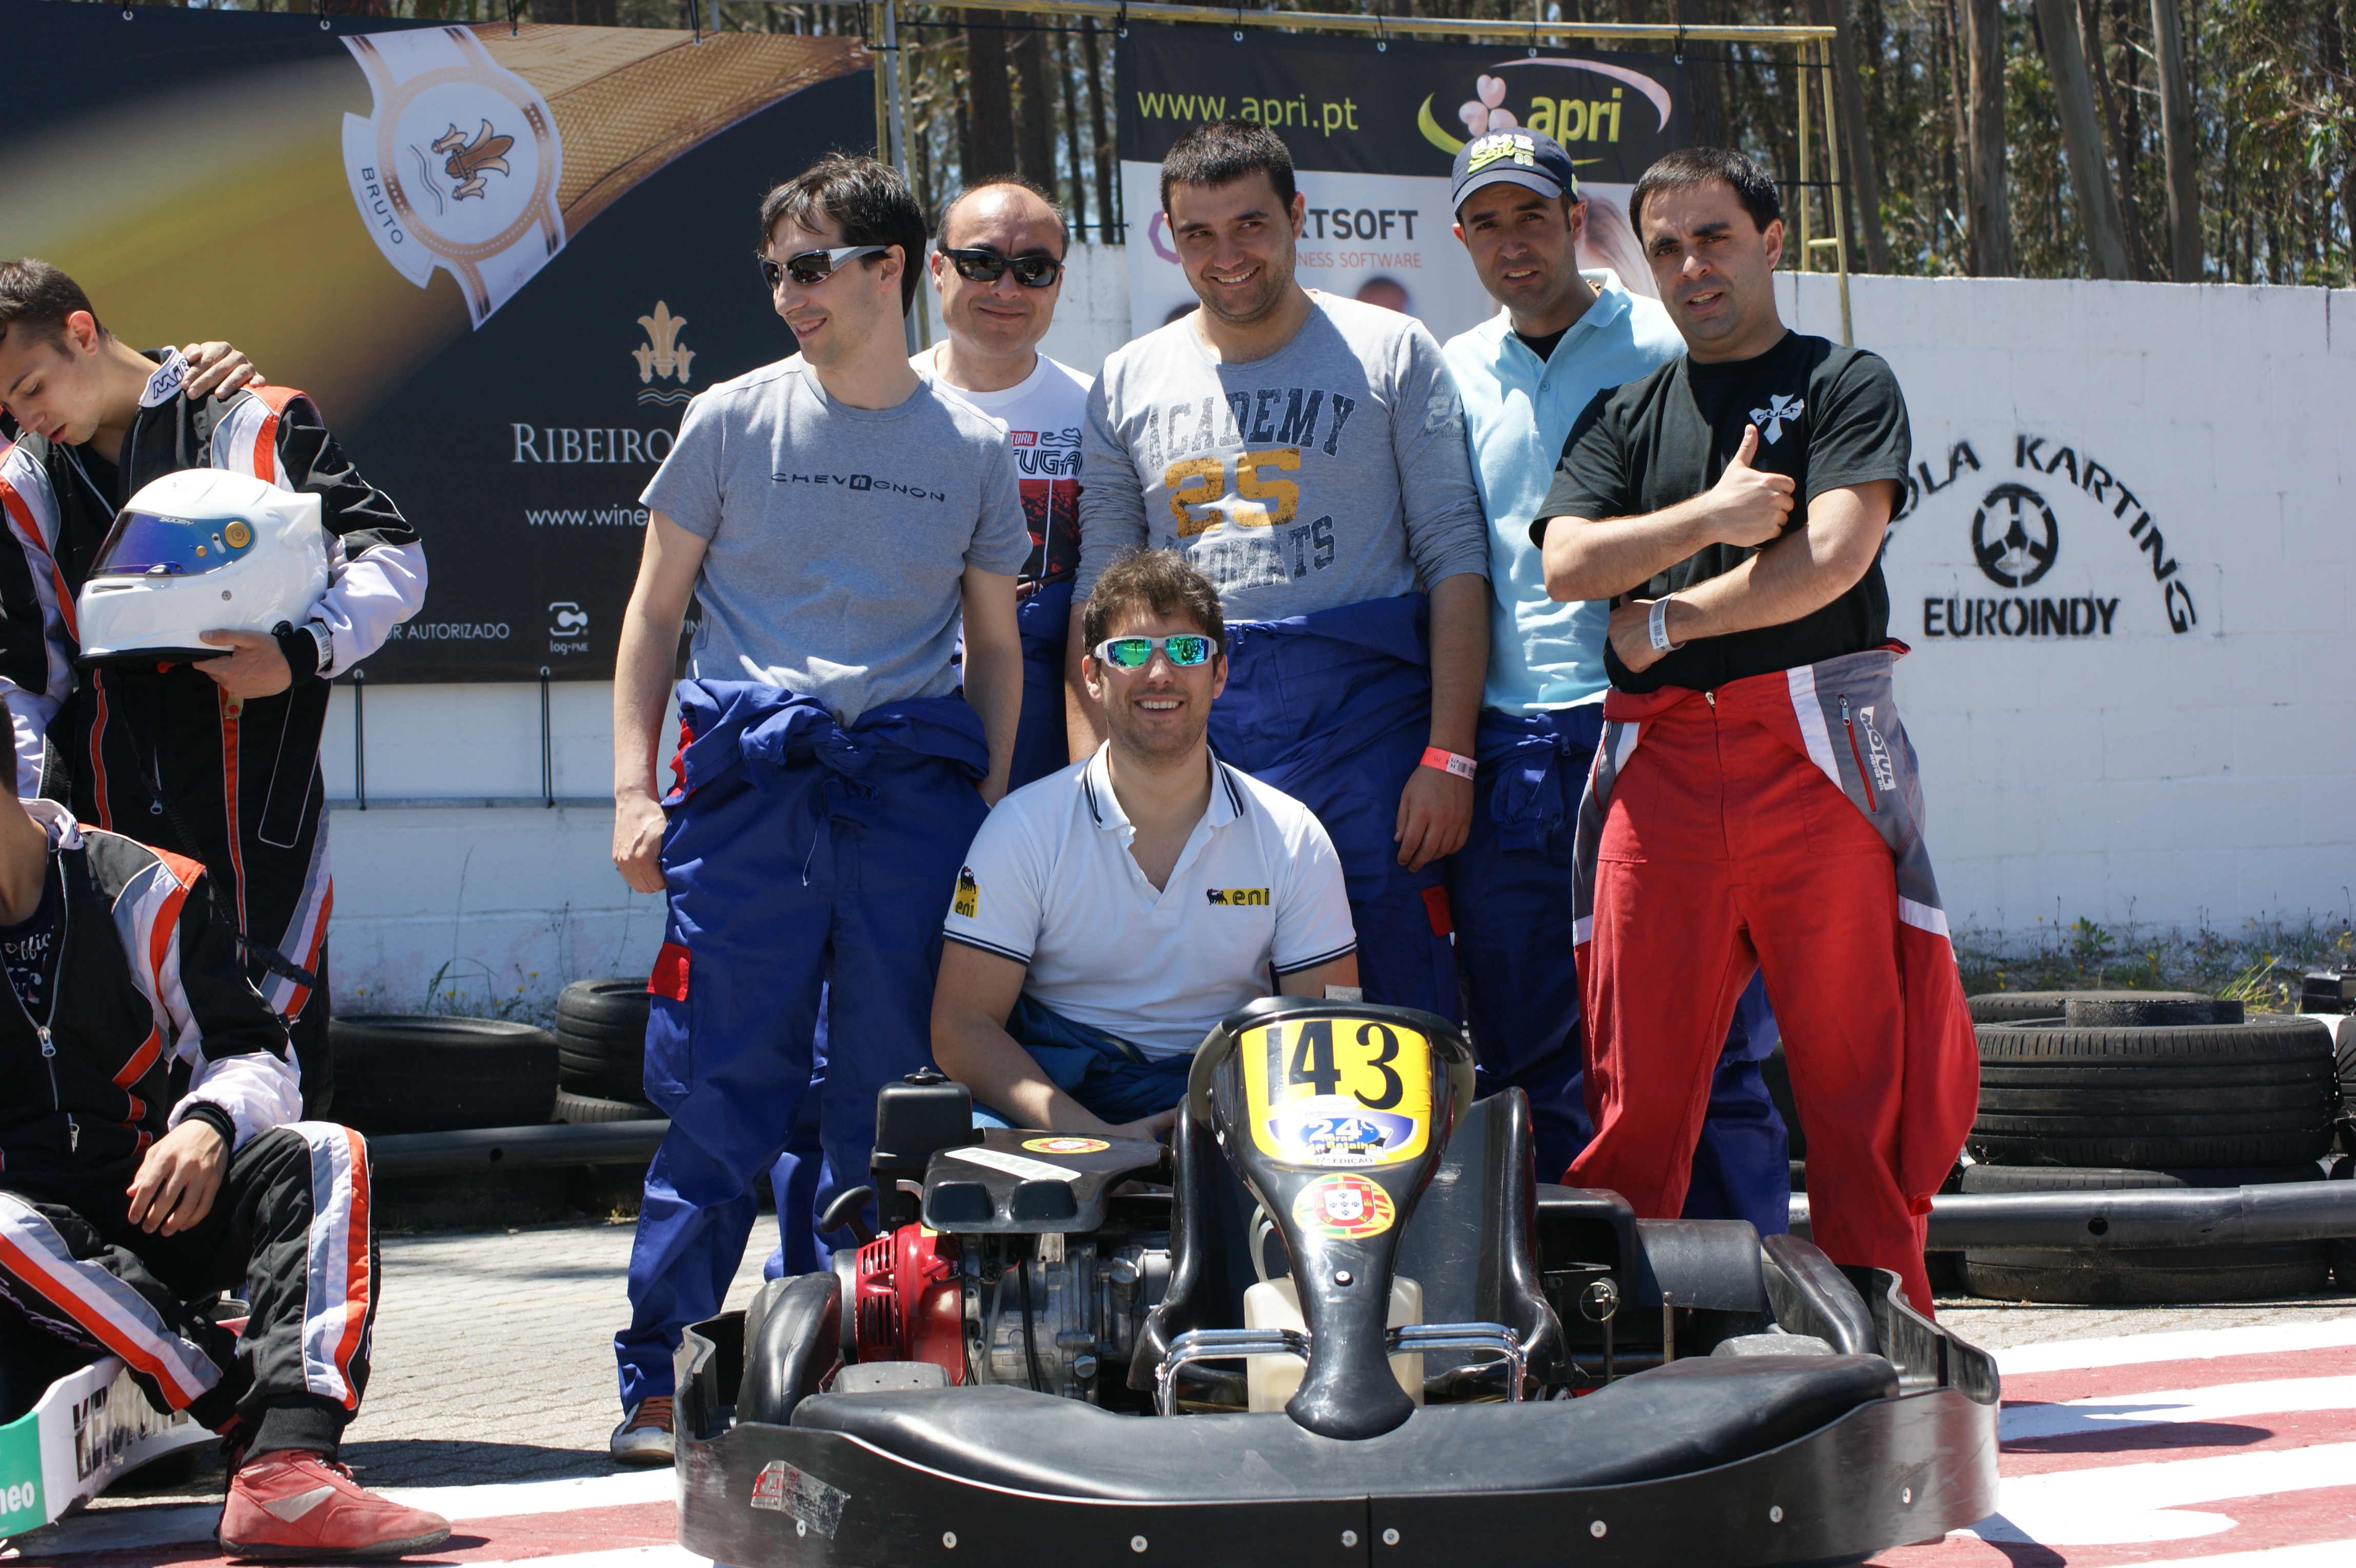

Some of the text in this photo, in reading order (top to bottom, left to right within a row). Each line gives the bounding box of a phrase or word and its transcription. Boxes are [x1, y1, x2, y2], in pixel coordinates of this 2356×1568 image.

[1527, 87, 1622, 151] apri
[361, 167, 404, 245] BRUTO
[1339, 252, 1422, 268] SOFTWARE
[1148, 387, 1356, 471] ACADEMY
[1164, 447, 1301, 539] 25
[2014, 434, 2196, 634] KARTING
[407, 623, 510, 639] AUTORIZADO
[1923, 596, 2121, 637] EUROINDY
[1861, 711, 1894, 787] MOTUL
[1869, 754, 1881, 778] MOTOR
[955, 898, 975, 918] eni
[1232, 888, 1270, 906] eni
[1266, 1020, 1404, 1110] 143
[1308, 1118, 1363, 1144] 24
[1326, 1141, 1378, 1150] Batalha
